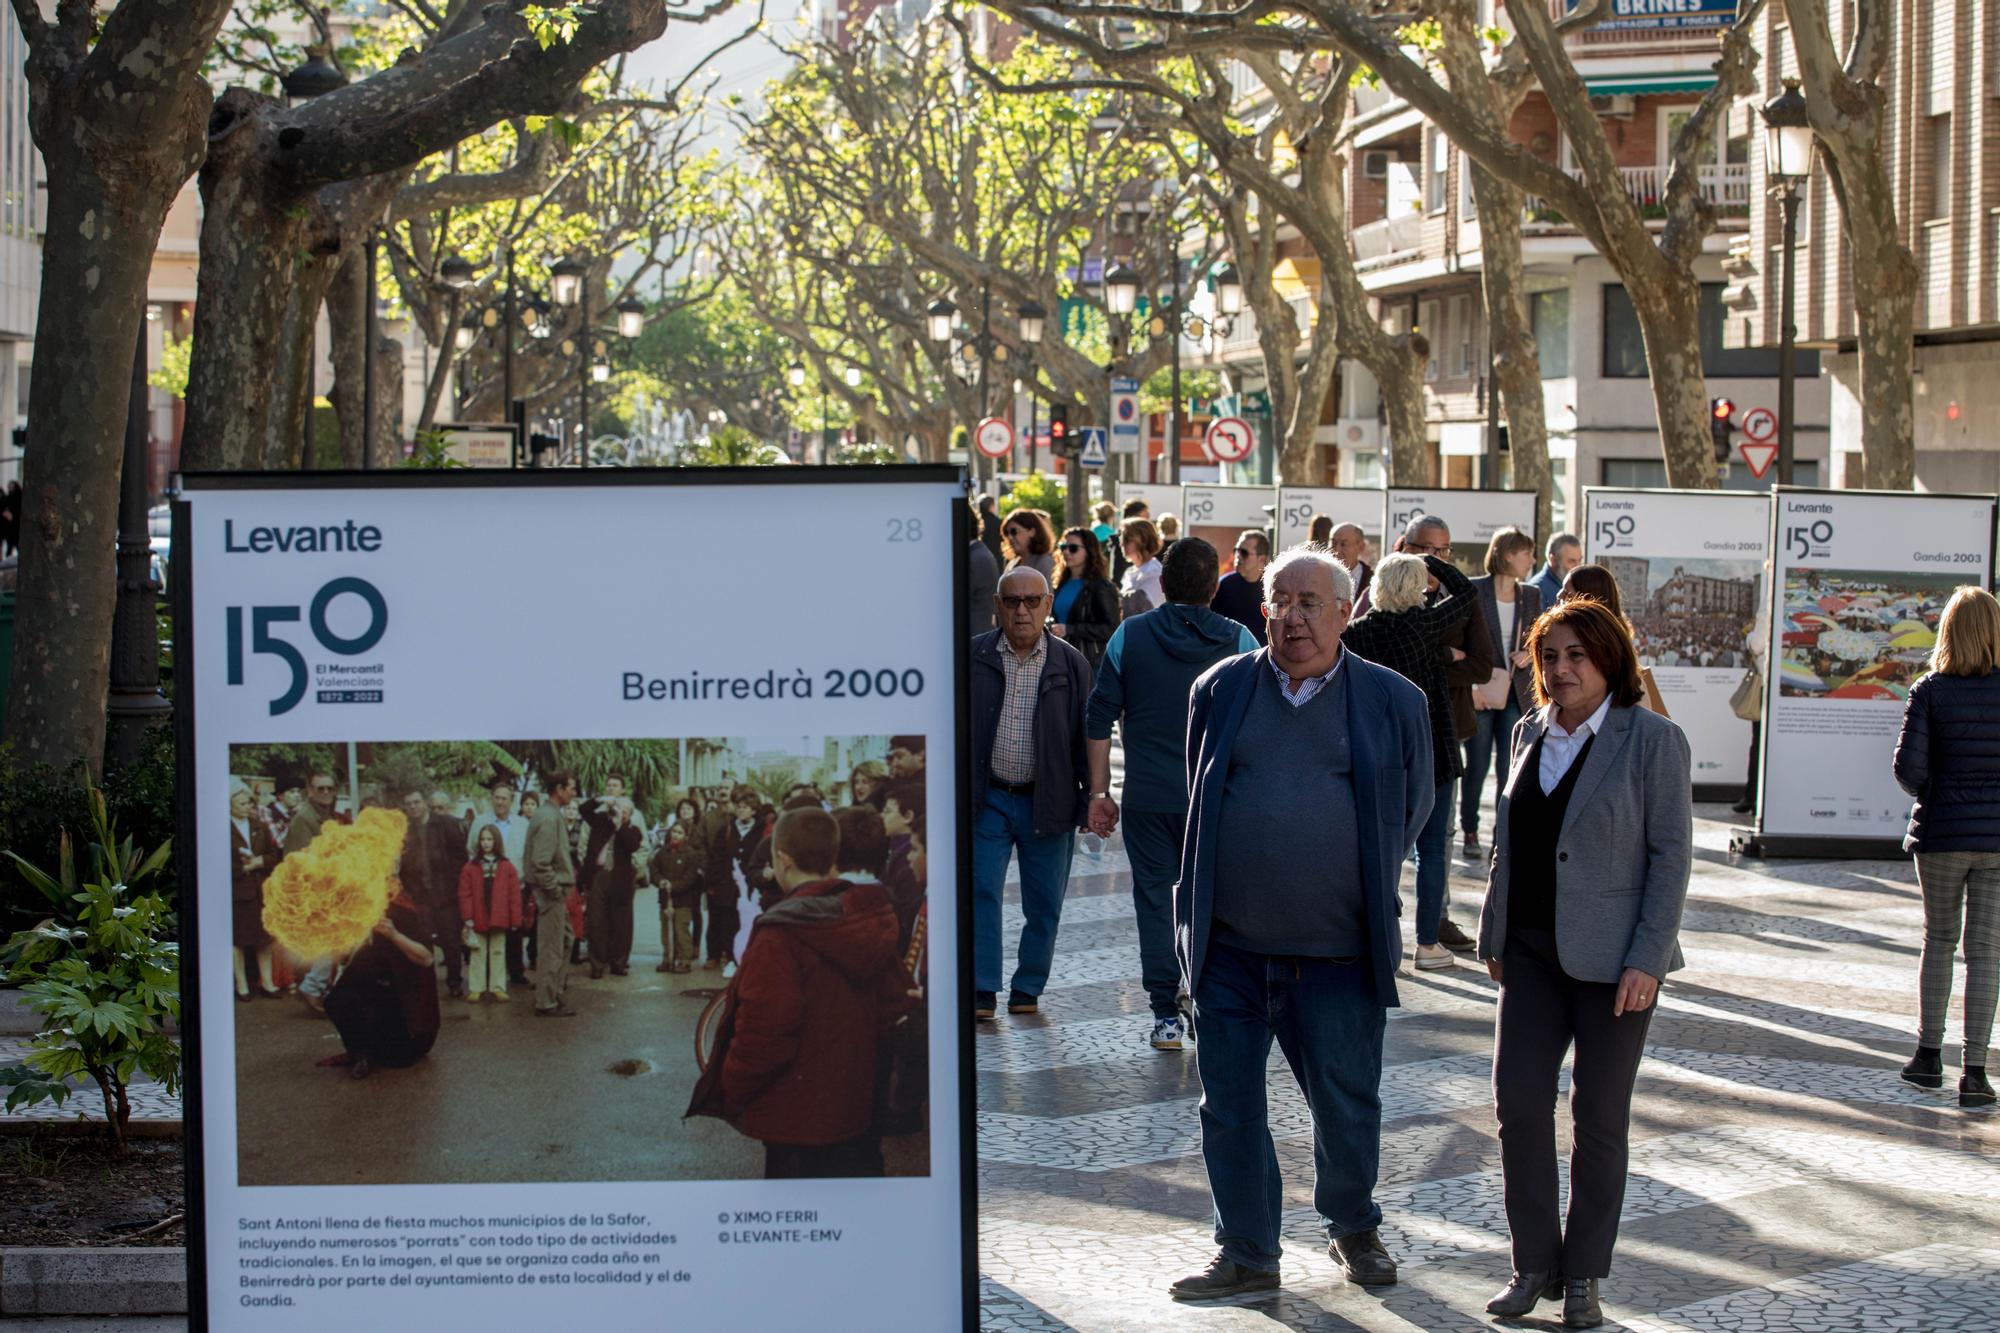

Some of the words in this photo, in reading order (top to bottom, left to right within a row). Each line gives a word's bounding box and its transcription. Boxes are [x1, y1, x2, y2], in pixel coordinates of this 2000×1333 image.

[1617, 0, 1702, 15] BRINES
[1663, 18, 1676, 27] DE
[1682, 16, 1720, 26] FINCAS
[1189, 500, 1214, 521] 150
[1596, 500, 1635, 510] Levante
[1788, 502, 1832, 514] Levante
[1284, 504, 1312, 528] 150
[225, 519, 382, 553] Levante
[886, 518, 923, 542] 28
[1595, 515, 1635, 549] 150
[1704, 541, 1736, 550] Gandia
[1738, 542, 1762, 551] 2003
[1786, 520, 1833, 560] 150
[1913, 552, 1950, 562] Gandia
[1953, 553, 1981, 564] 2003
[226, 576, 389, 716] 150
[316, 664, 327, 674] El
[329, 664, 384, 674] Mercantil
[316, 677, 384, 687] Valenciano
[623, 668, 812, 700] Benirredrà
[824, 668, 925, 698] 2000
[321, 692, 343, 702] 1872
[354, 692, 380, 701] 2022
[238, 1218, 271, 1230] Sant
[276, 1217, 322, 1230] Antoni
[325, 1217, 360, 1229] llena
[362, 1216, 381, 1229] de
[384, 1216, 426, 1229] fiesta
[429, 1215, 485, 1228] muchos
[488, 1214, 565, 1229] municipios
[569, 1214, 587, 1227] de
[590, 1214, 604, 1226] la
[607, 1213, 651, 1227] Safor,
[734, 1211, 772, 1224] XIMO
[776, 1210, 818, 1223] FERRI
[239, 1236, 316, 1252] incluyendo
[320, 1237, 397, 1249] numerosos
[469, 1236, 496, 1247] con
[499, 1234, 533, 1247] todo
[537, 1233, 566, 1248] tipo
[569, 1233, 588, 1246] de
[591, 1232, 677, 1246] actividades
[734, 1229, 842, 1243] LEVANTE-EMV
[239, 1256, 338, 1269] tradicionales.
[342, 1255, 360, 1268] En
[362, 1254, 376, 1267] la
[379, 1254, 436, 1270] imagen,
[440, 1254, 453, 1266] el
[456, 1255, 482, 1269] que
[486, 1255, 501, 1266] se
[506, 1253, 568, 1268] organiza
[571, 1252, 609, 1265] cada
[612, 1252, 640, 1264] año
[643, 1253, 660, 1264] en
[239, 1274, 315, 1288] Benirredrà
[318, 1276, 343, 1290] por
[346, 1274, 386, 1289] parte
[389, 1274, 411, 1286] del
[415, 1273, 514, 1289] ayuntamiento
[517, 1272, 536, 1285] de
[539, 1272, 571, 1285] esta
[574, 1271, 642, 1284] localidad
[645, 1273, 654, 1287] y
[657, 1271, 670, 1283] el
[673, 1270, 692, 1283] de
[239, 1294, 296, 1308] Gandia.
